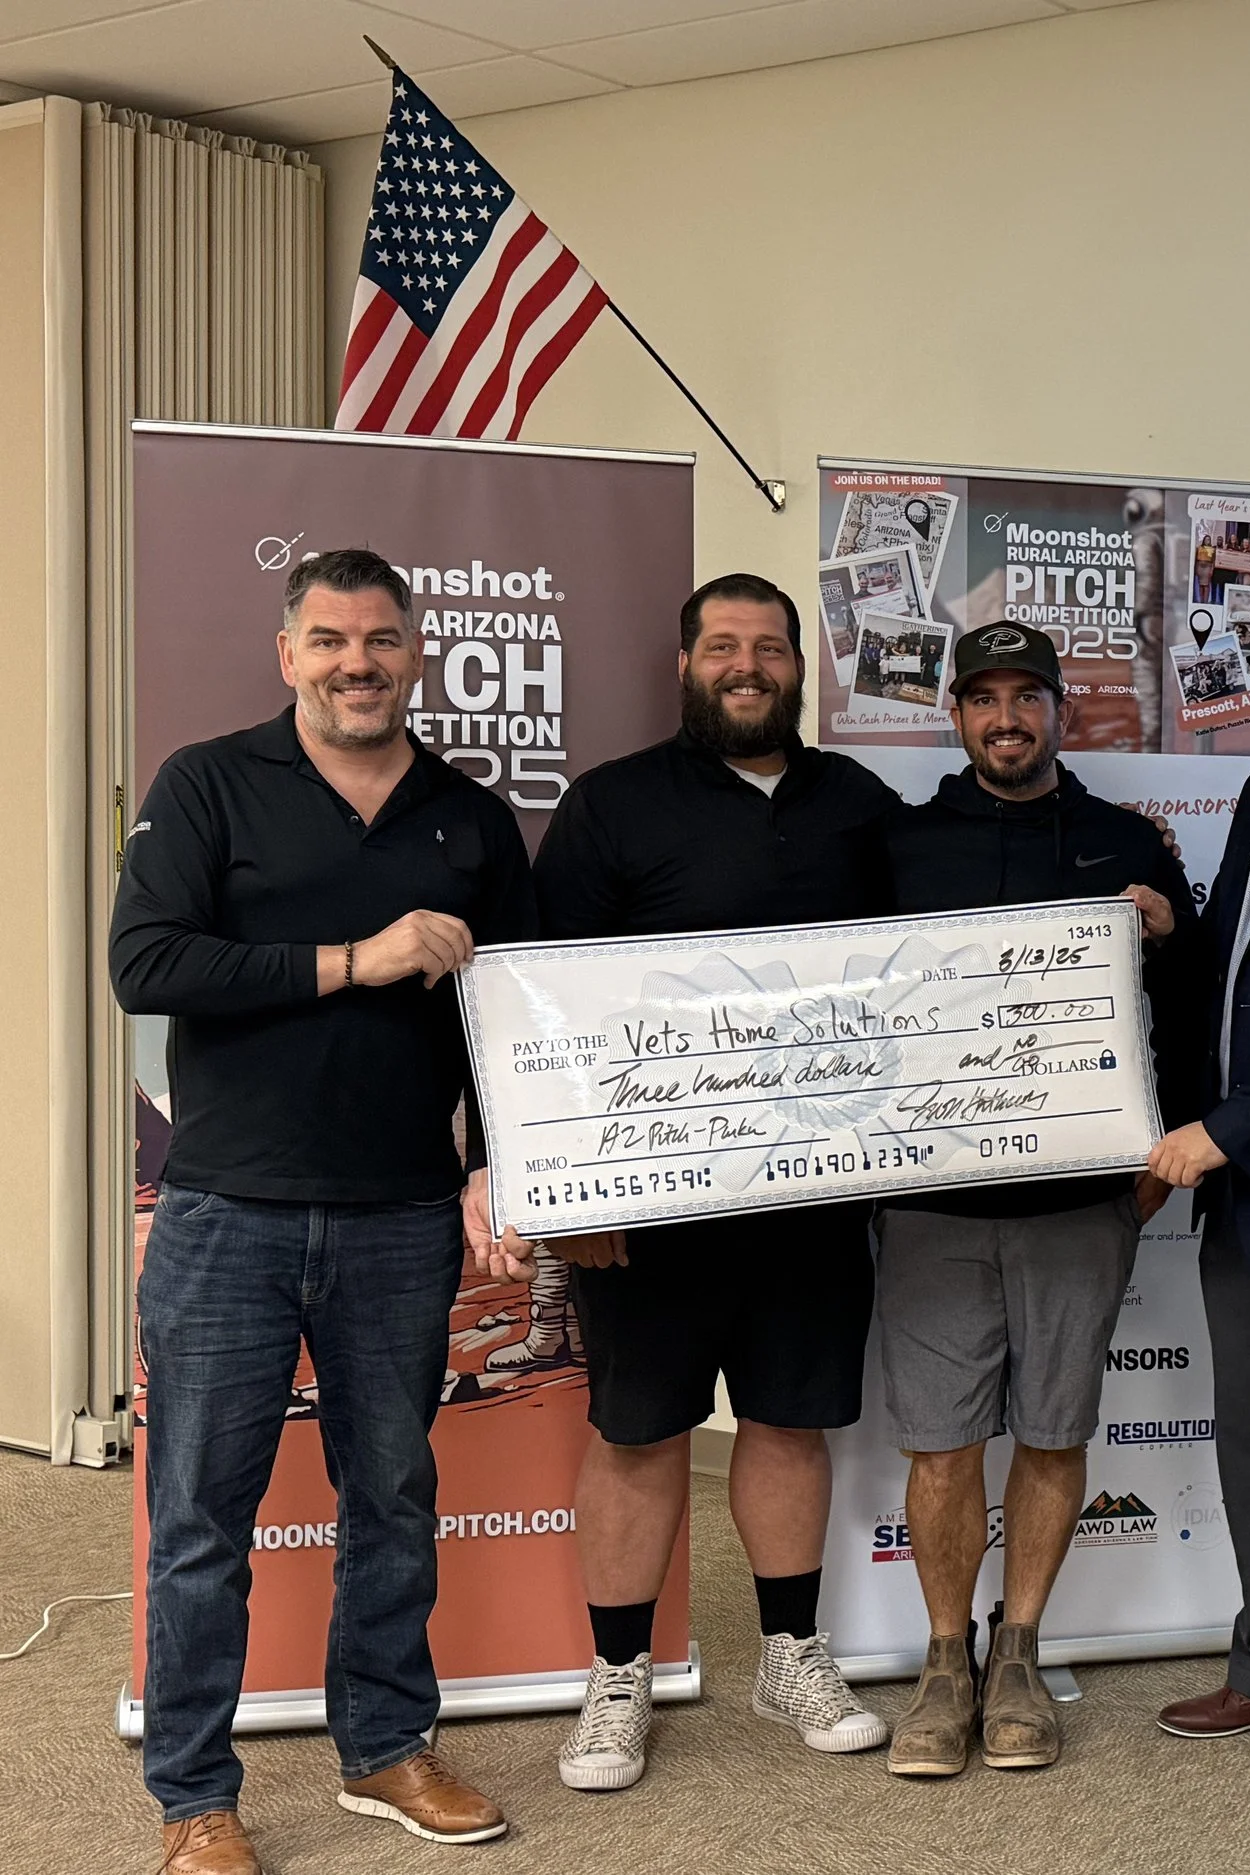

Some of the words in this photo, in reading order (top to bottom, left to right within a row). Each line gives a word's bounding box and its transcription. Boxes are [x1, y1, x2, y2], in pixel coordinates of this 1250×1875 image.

[834, 475, 858, 485] JOIN
[859, 476, 873, 485] US
[874, 476, 889, 485] ON
[890, 476, 910, 485] THE
[911, 476, 941, 486] ROAD!
[1194, 498, 1214, 510] Last
[1217, 499, 1247, 514] Year's
[874, 525, 911, 538] ARIZONA
[1006, 523, 1133, 549] Moonshot
[1007, 546, 1061, 563] RURAL
[1064, 550, 1135, 567] ARIZONA
[1006, 564, 1135, 608] PITCH
[420, 610, 562, 641] ARIZONA
[1004, 604, 1134, 626] COMPETITION
[1040, 624, 1138, 660] 025
[1070, 684, 1091, 696] aps
[1097, 685, 1139, 694] ARIZONA
[837, 714, 857, 725] Win
[860, 713, 880, 725] Cash
[911, 713, 920, 724] &
[1182, 699, 1240, 721] Prescott,
[406, 712, 561, 747] ETITION
[1067, 924, 1112, 940] 13413
[922, 967, 957, 983] DATE
[624, 1020, 693, 1057] Vets
[708, 1005, 779, 1050] Home
[790, 995, 941, 1046] Solutions
[981, 1012, 995, 1029] $
[512, 1041, 547, 1057] PAY
[549, 1038, 572, 1053] TO
[573, 1034, 608, 1050] THE
[514, 1057, 571, 1074] ORDER
[574, 1053, 597, 1068] OF
[1021, 1058, 1098, 1077] DOLLARS
[599, 1063, 688, 1112] Three
[525, 1156, 568, 1173] MEMO
[1157, 1230, 1174, 1241] and
[1106, 1347, 1190, 1372] NSORS
[1107, 1419, 1215, 1445] RESOLUTIO
[1075, 1520, 1114, 1536] AWD
[1120, 1517, 1158, 1533] LAW
